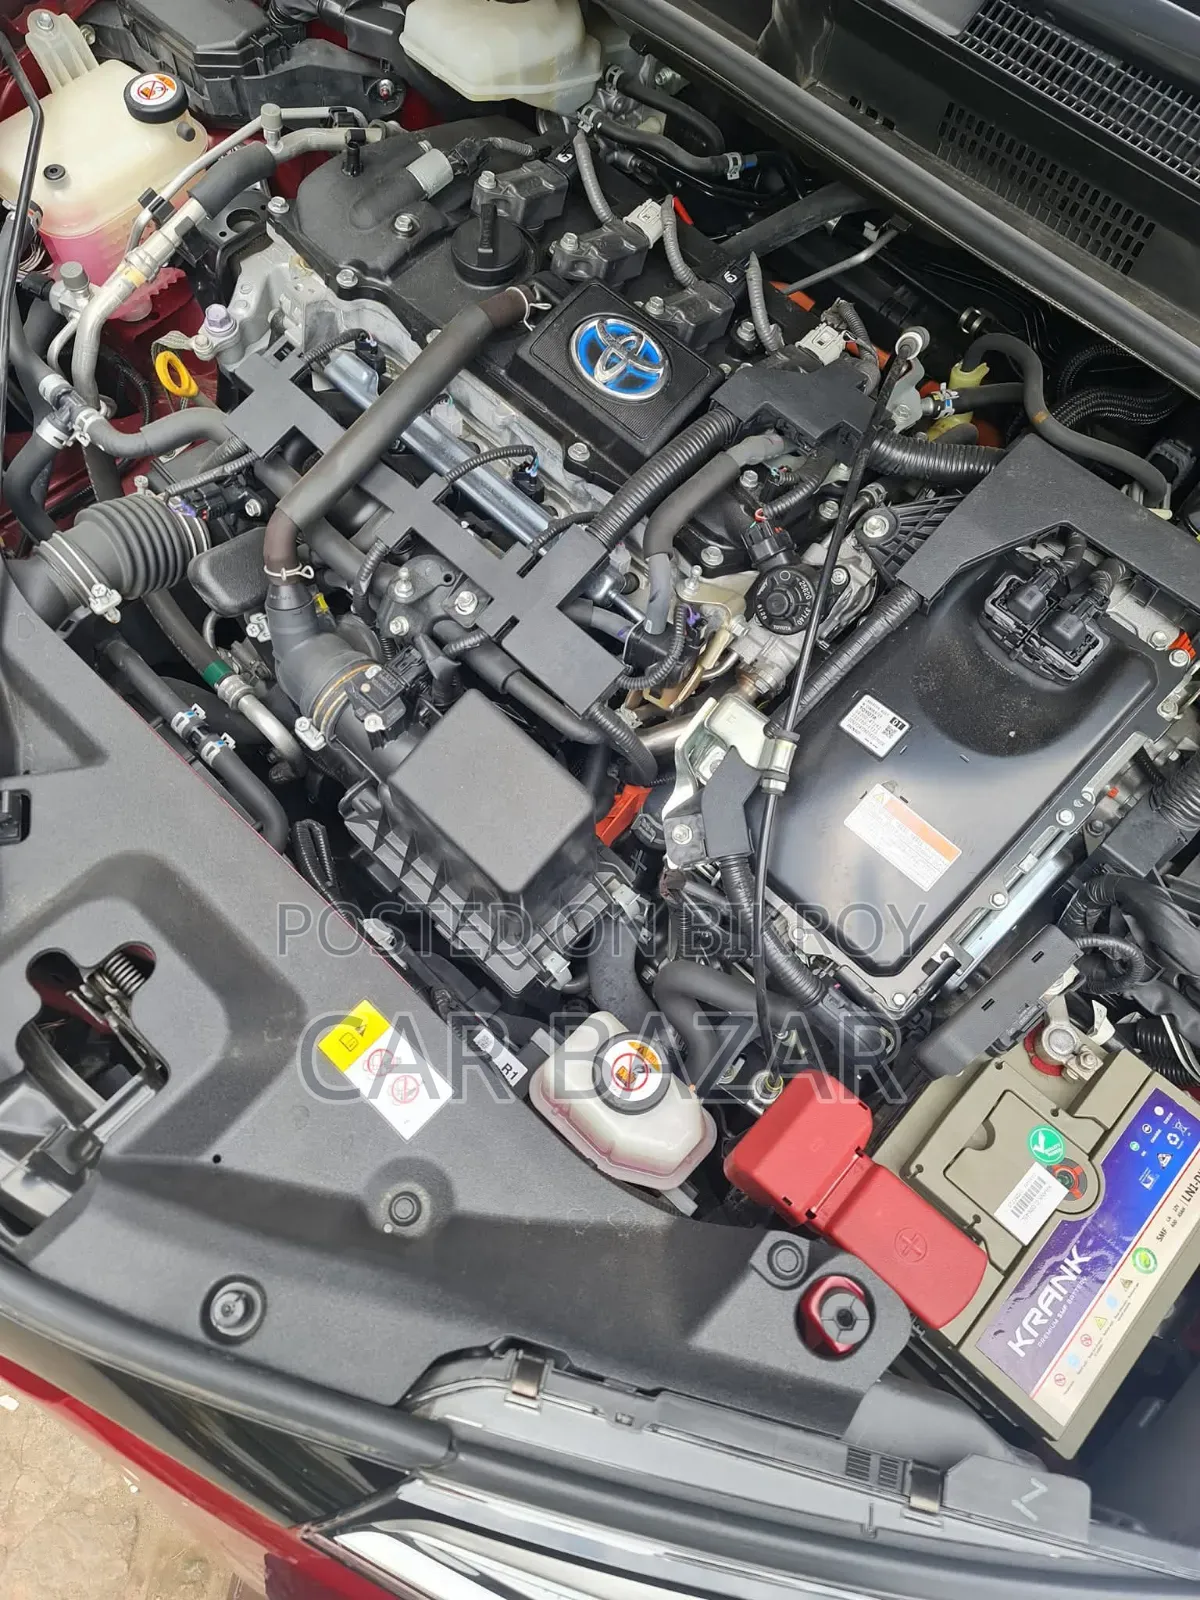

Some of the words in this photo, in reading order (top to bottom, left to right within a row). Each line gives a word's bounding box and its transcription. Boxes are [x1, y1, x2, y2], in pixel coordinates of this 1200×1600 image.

[502, 1063, 519, 1080] R1
[1006, 1245, 1092, 1358] KRANK
[1037, 1318, 1061, 1348] PREMIUM
